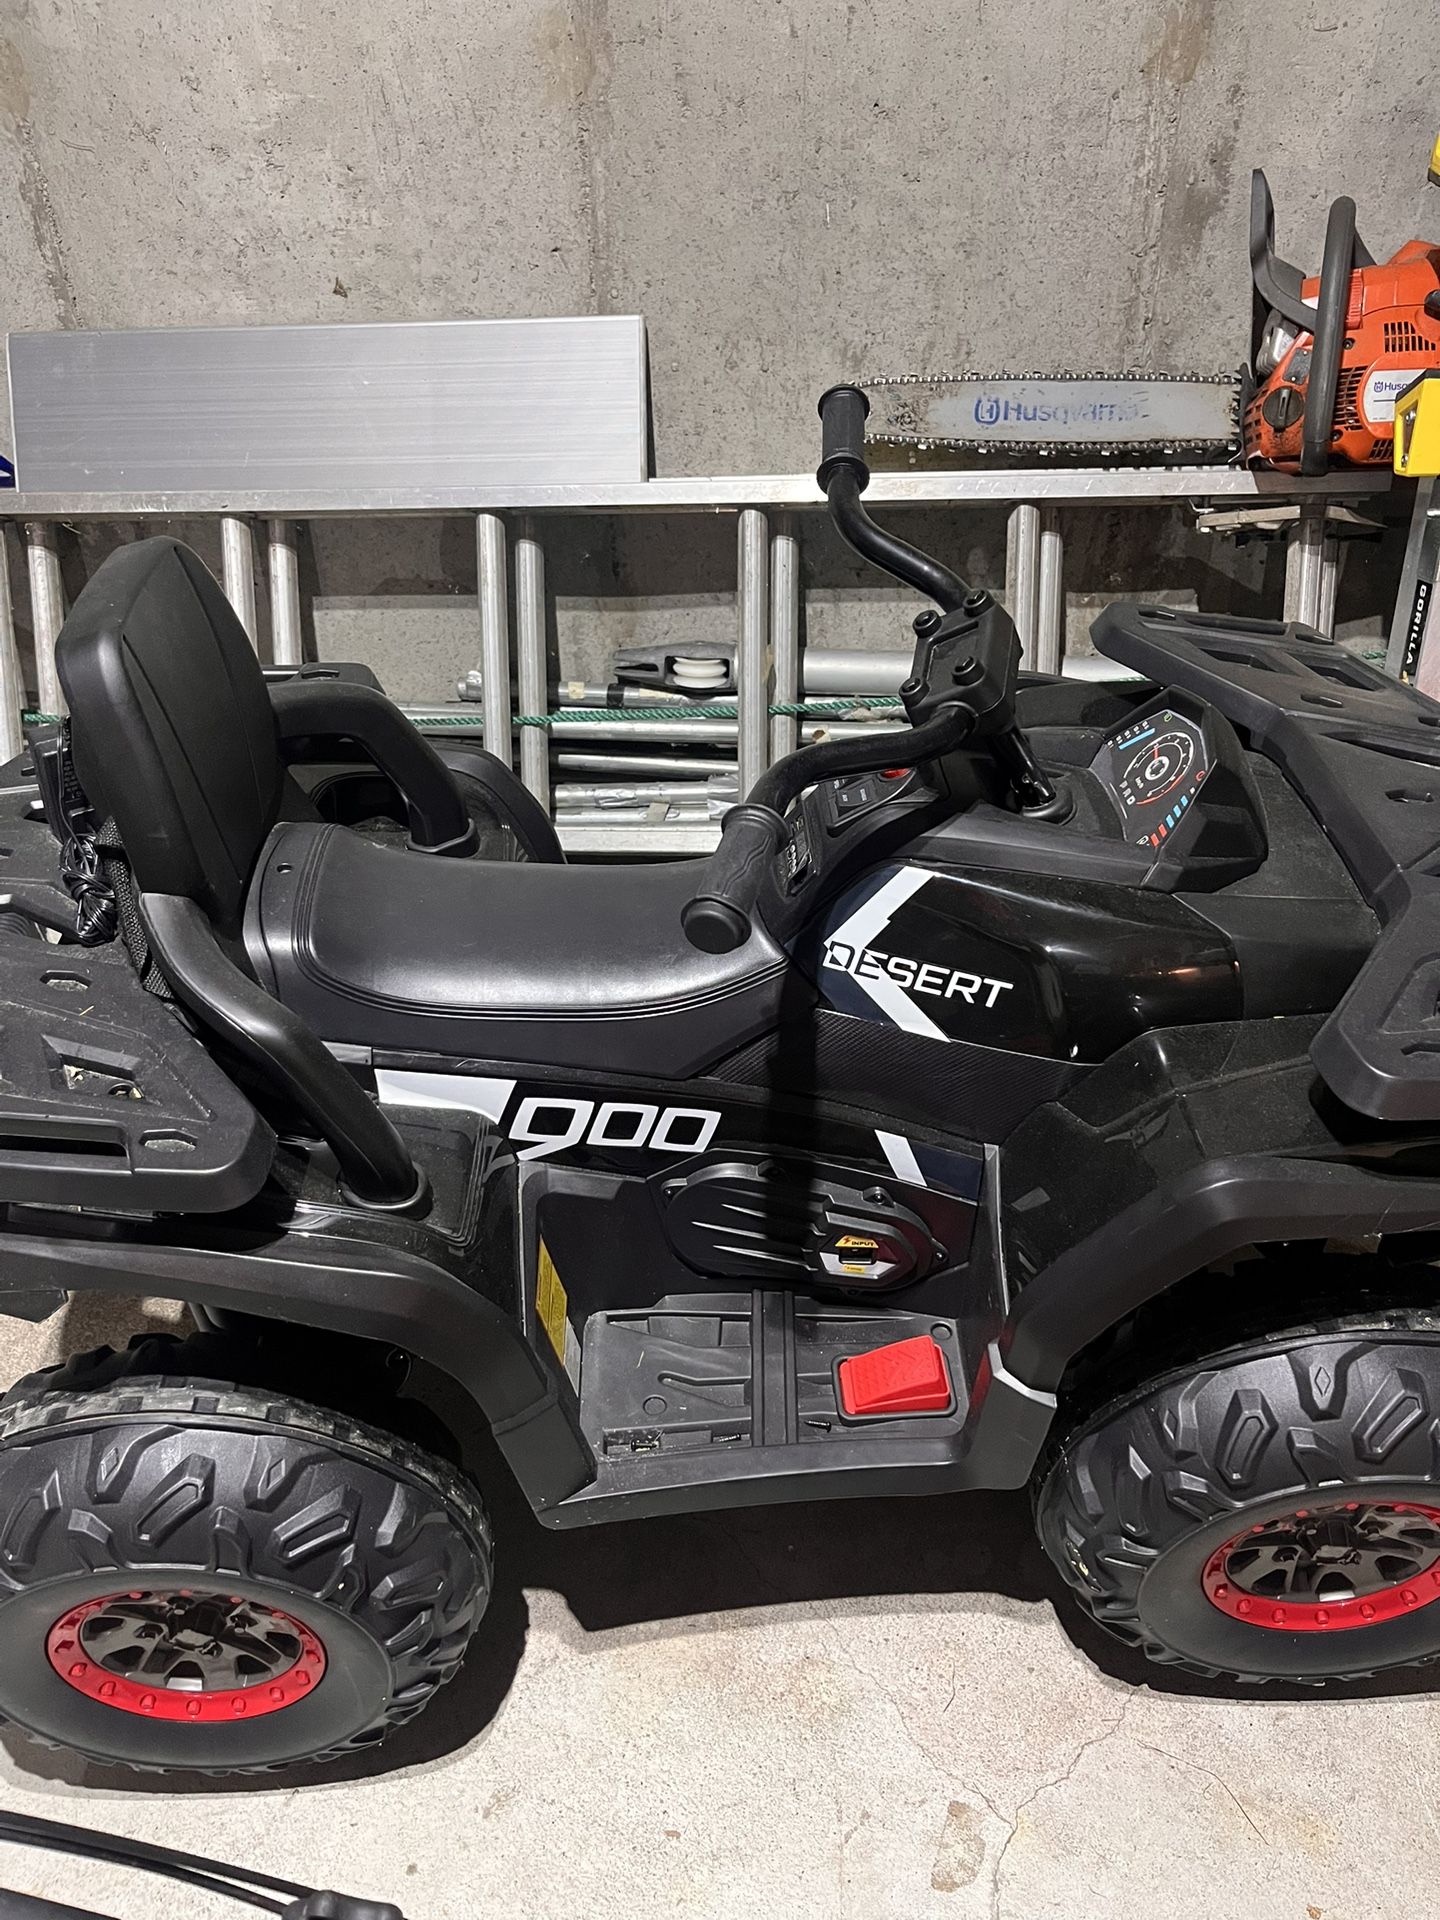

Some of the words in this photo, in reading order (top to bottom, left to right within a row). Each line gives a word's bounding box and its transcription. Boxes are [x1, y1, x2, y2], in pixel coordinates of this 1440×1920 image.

[1405, 584, 1427, 665] GORILLA
[822, 940, 1014, 1009] DESERT
[508, 1097, 722, 1162] 900
